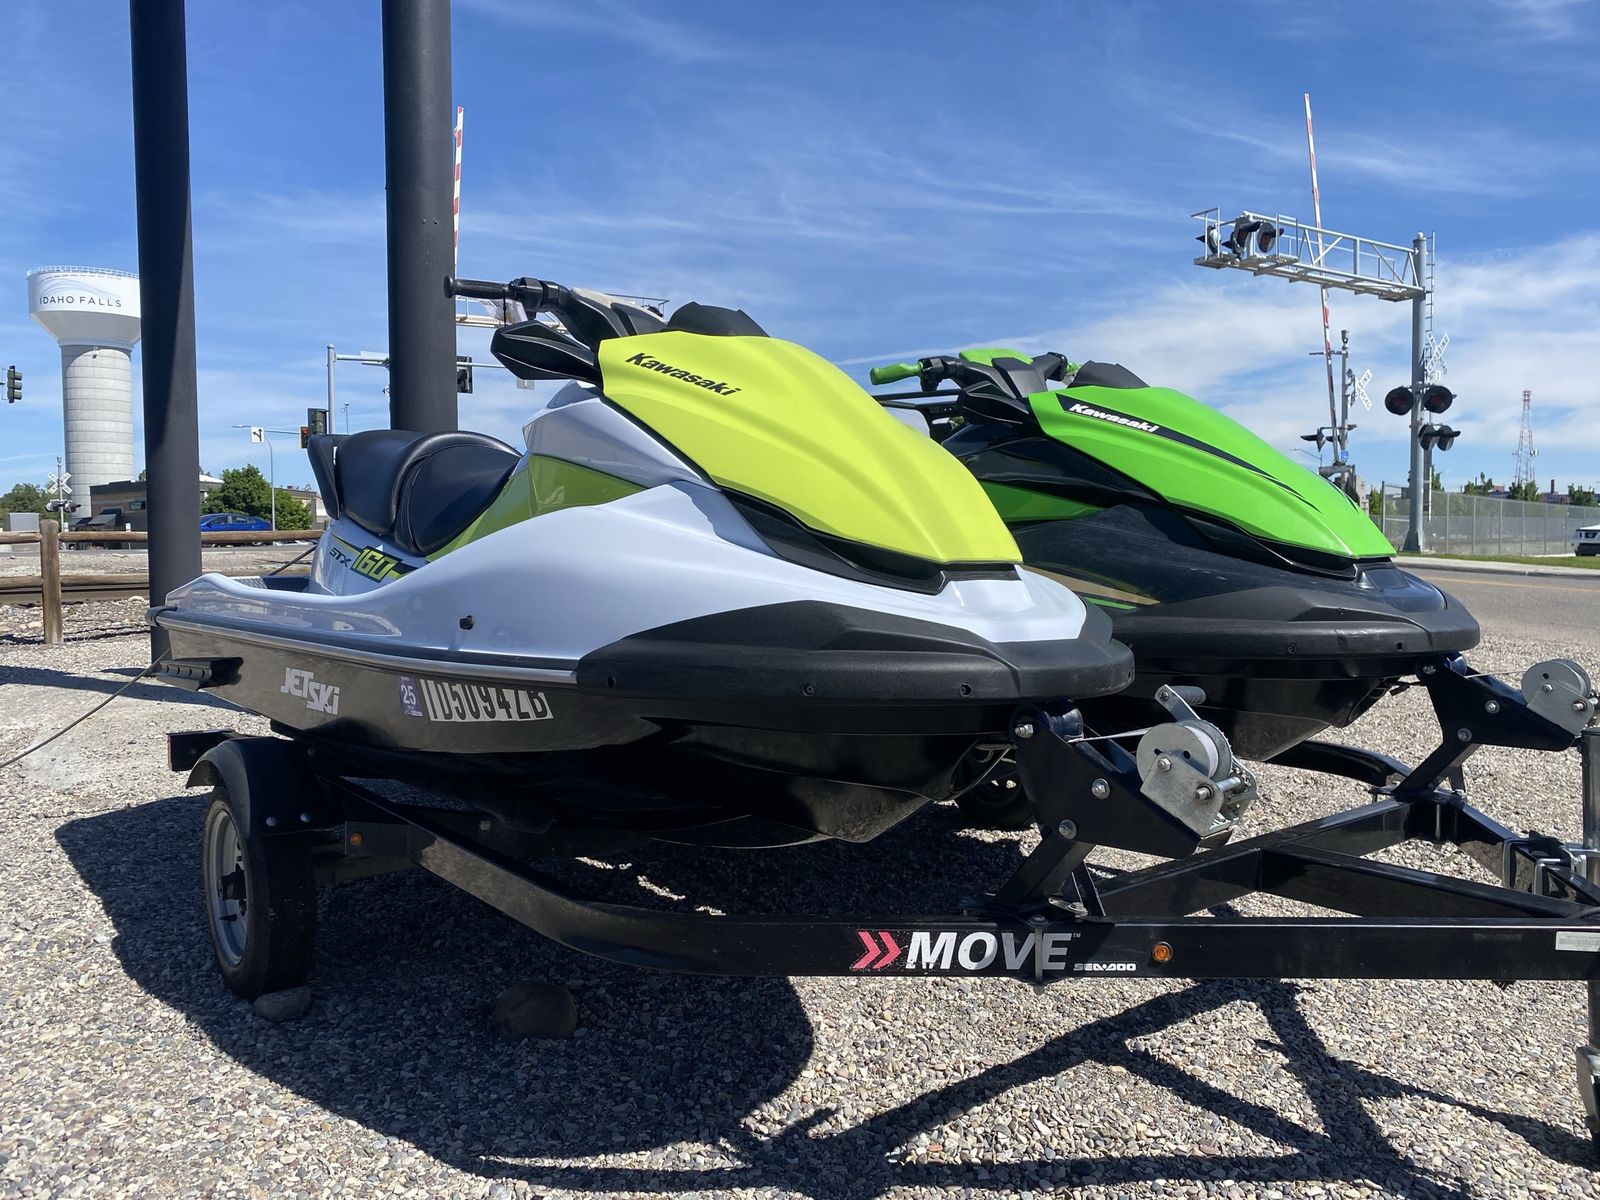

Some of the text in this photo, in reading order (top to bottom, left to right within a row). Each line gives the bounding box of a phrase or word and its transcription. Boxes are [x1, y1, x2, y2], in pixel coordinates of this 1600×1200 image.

[39, 295, 122, 308] IDAHO FALLS
[625, 352, 742, 396] Kawasaki
[1068, 403, 1160, 433] Kawasaki
[329, 547, 399, 581] STX 160
[280, 667, 315, 699] JET
[400, 684, 417, 706] 25
[905, 931, 1073, 971] MOVE
